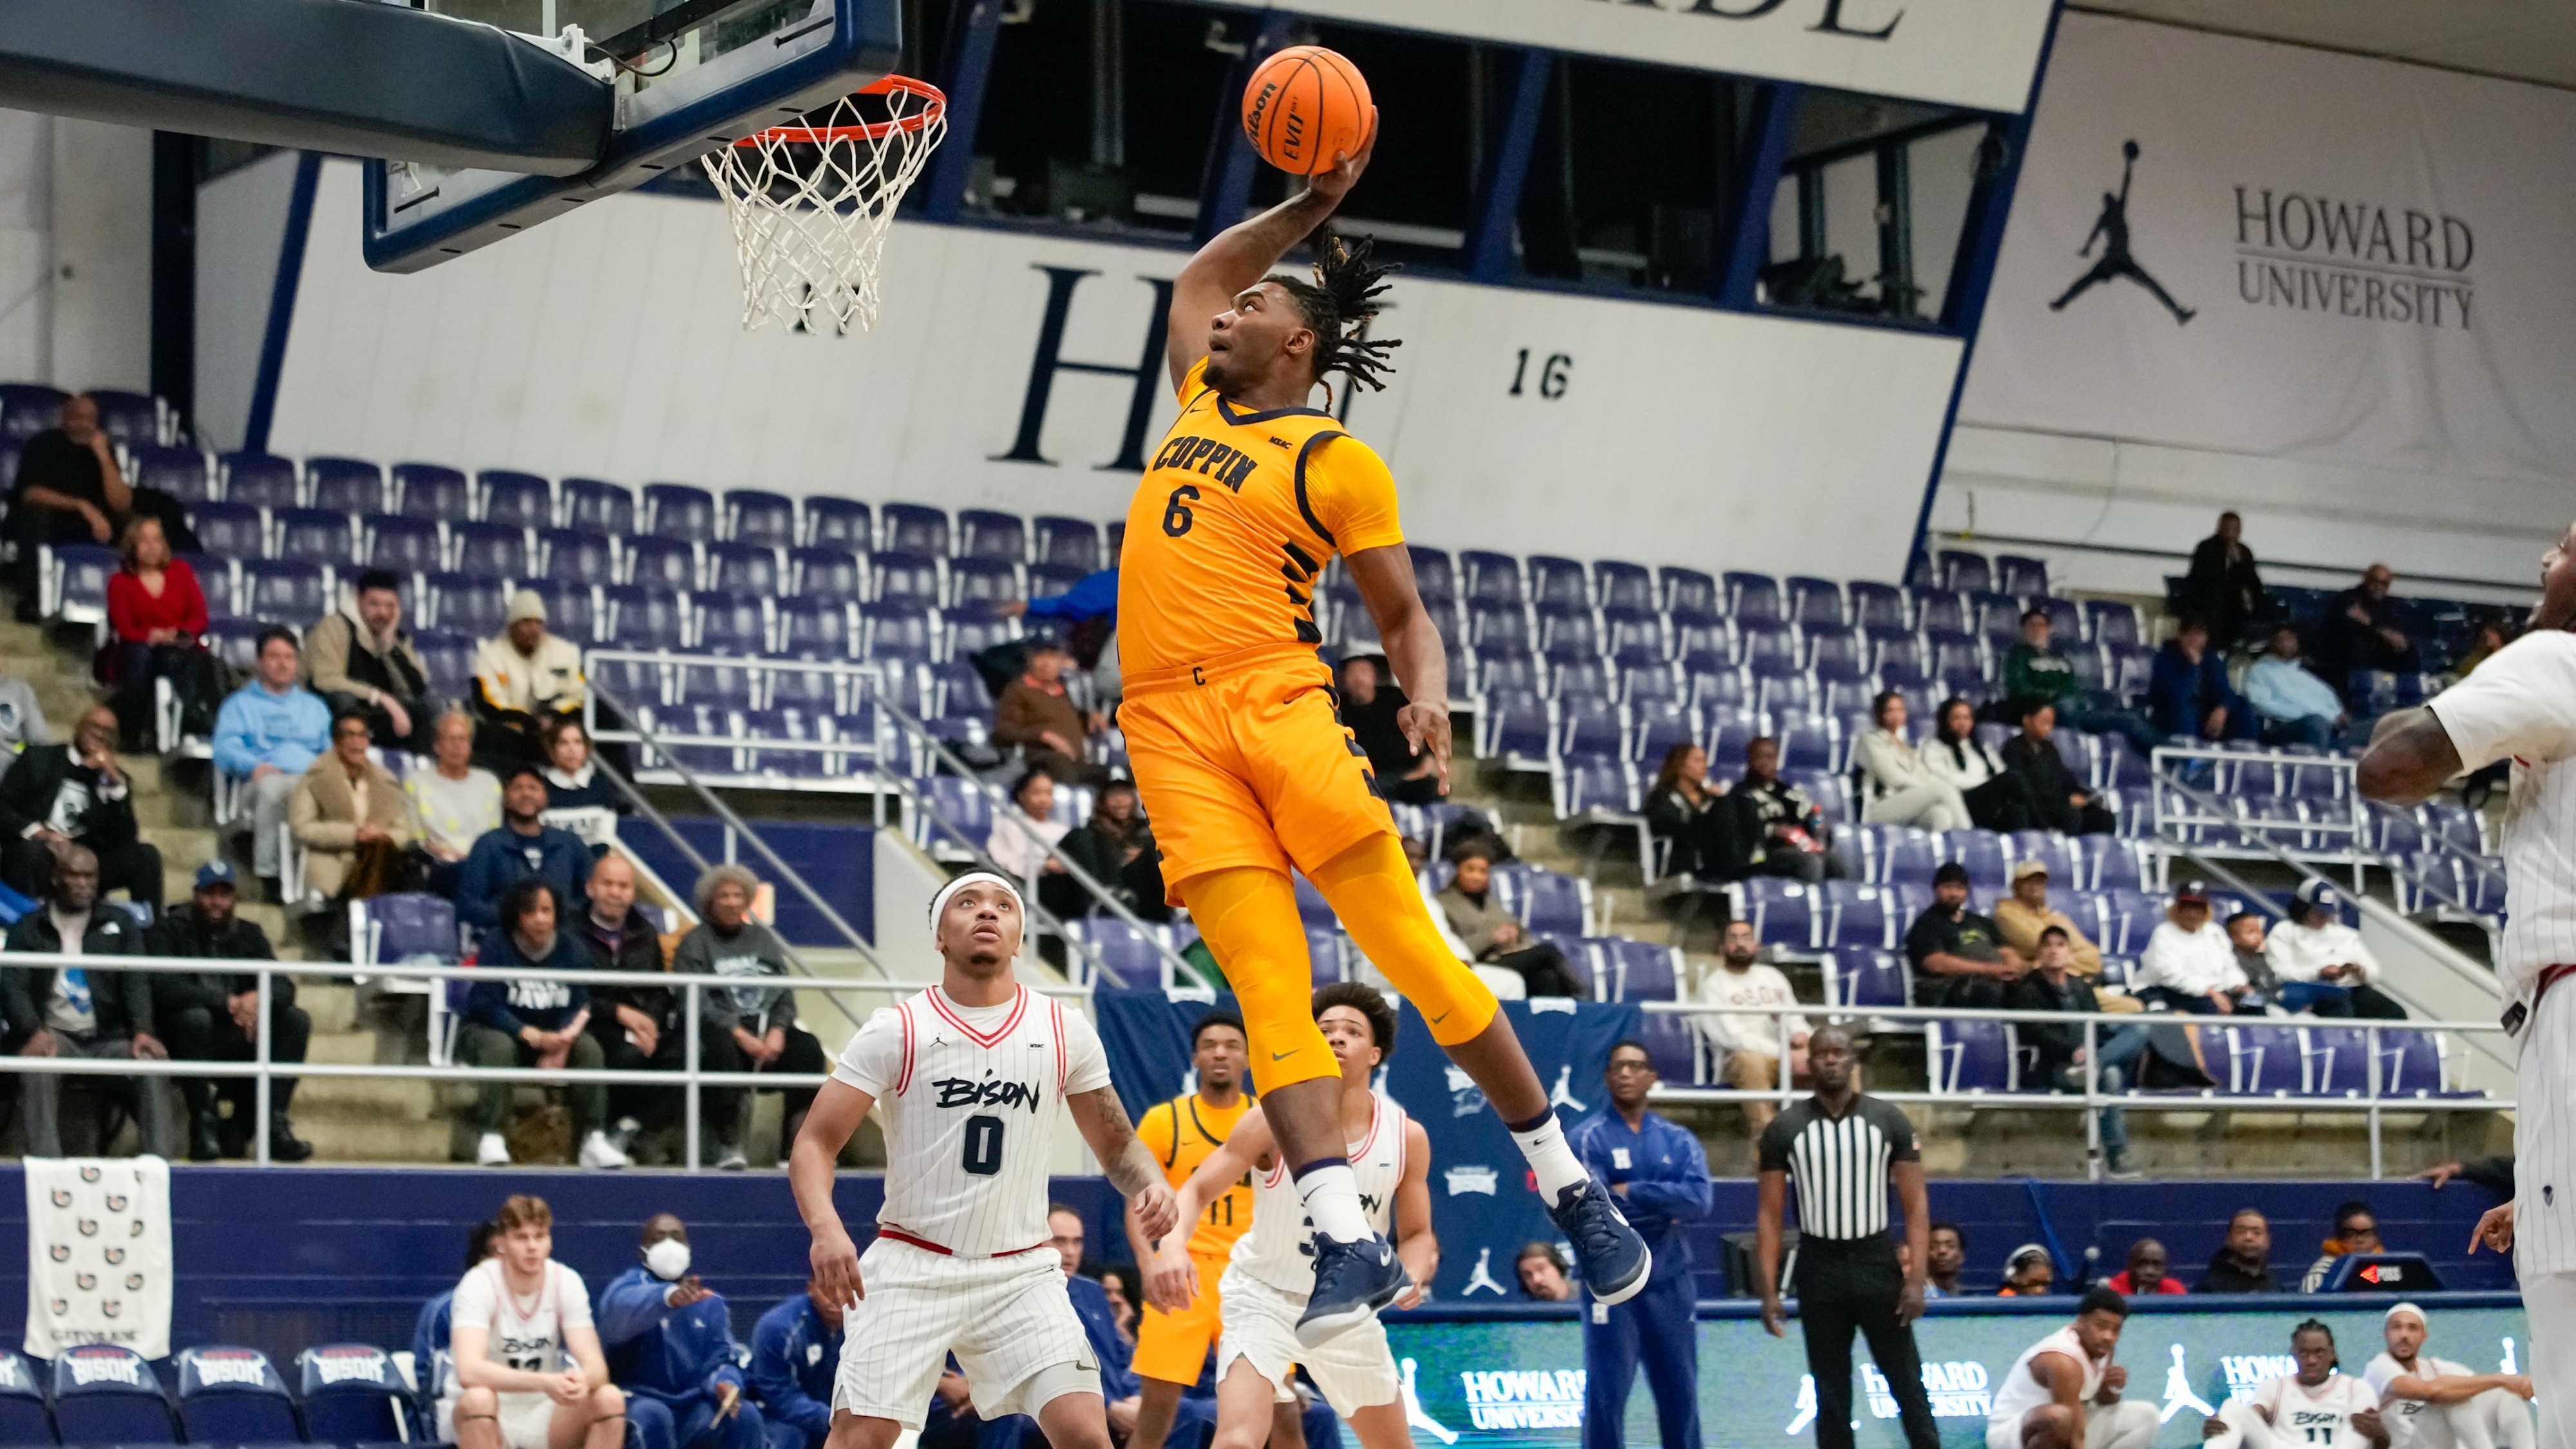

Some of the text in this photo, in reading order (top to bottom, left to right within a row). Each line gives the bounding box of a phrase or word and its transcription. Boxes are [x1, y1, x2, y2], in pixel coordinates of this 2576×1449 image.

[2234, 185, 2475, 274] HOWARD
[2237, 261, 2475, 330] UNIVERSITY
[1509, 348, 1573, 400] 16
[1153, 435, 1258, 494] COPPIN
[1162, 484, 1200, 537] 6
[1193, 667, 1206, 686] C
[962, 1113, 1005, 1177] 0
[71, 1356, 140, 1386] BISON
[197, 1358, 266, 1387] BISON
[317, 1356, 386, 1385] BISON
[2306, 1428, 2331, 1445] 11
